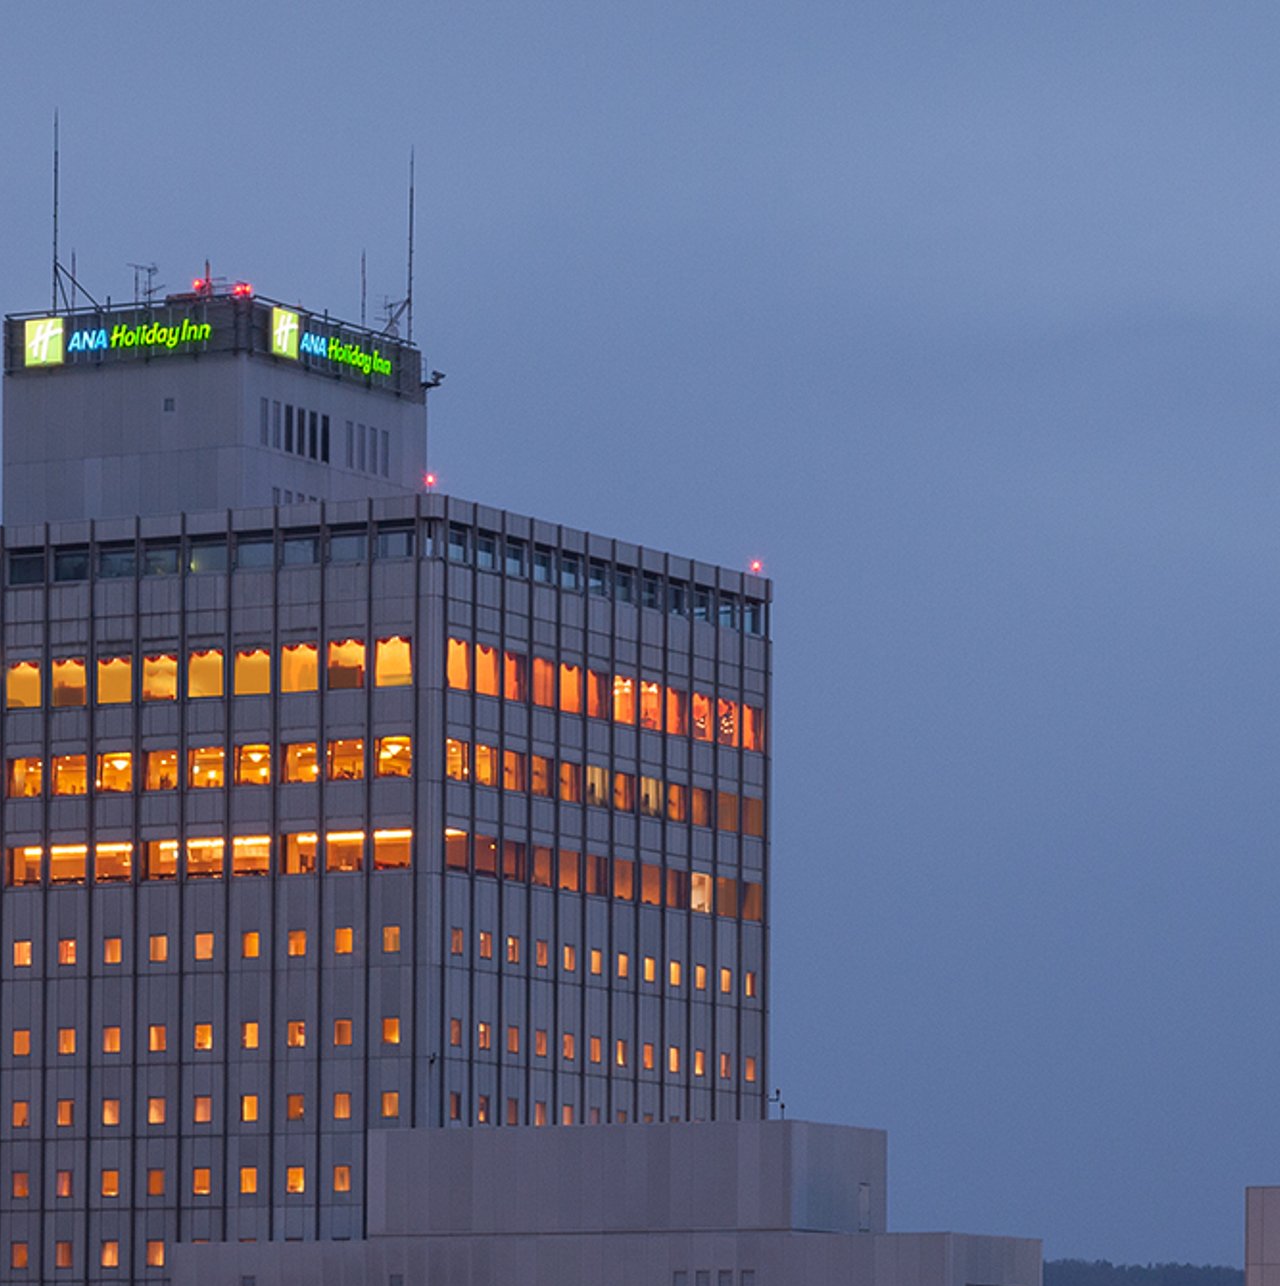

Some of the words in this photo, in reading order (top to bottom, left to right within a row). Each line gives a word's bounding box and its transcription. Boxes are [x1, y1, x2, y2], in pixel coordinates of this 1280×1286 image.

[68, 329, 108, 352] ANA
[110, 322, 180, 348] Holiday
[181, 318, 212, 341] Inn
[300, 332, 327, 358] ANA
